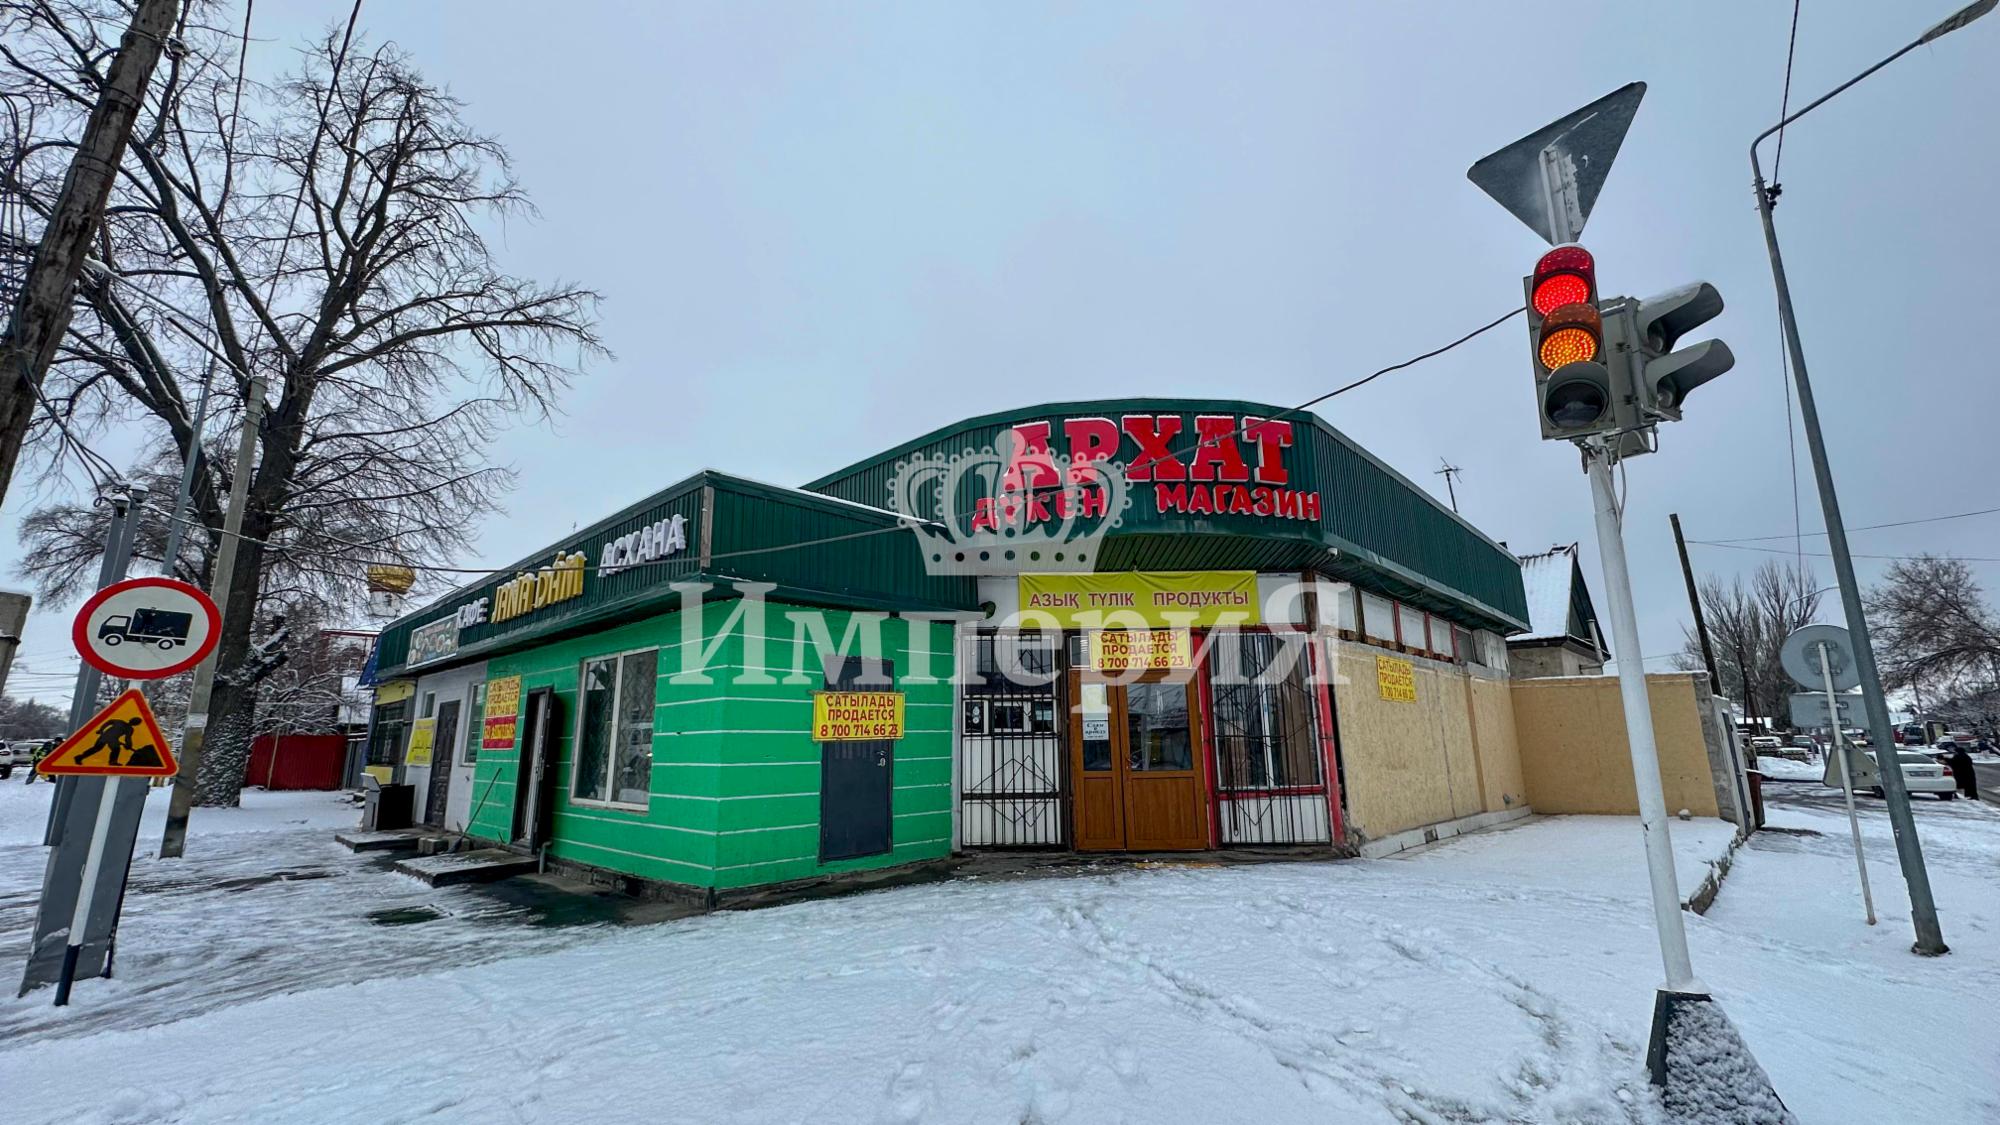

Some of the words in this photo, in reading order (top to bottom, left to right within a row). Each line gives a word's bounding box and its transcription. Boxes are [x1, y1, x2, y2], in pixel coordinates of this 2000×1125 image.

[1003, 414, 1293, 488] АРХАТ
[1154, 483, 1321, 521] МАГАЗИН
[598, 514, 688, 577] АСХАНА
[1029, 592, 1079, 609] АЗЫҚ
[1088, 592, 1135, 607] ТҮЛІК
[1153, 591, 1249, 608] ПРОДУКТЫ
[456, 597, 488, 629] КАФЕ
[1100, 631, 1178, 644] САТЫЛАДЫ
[1102, 643, 1177, 656] ПРОДАЕТСЯ
[1097, 658, 1105, 668] 8
[1107, 657, 1129, 668] 700
[1131, 657, 1151, 668] 714
[1154, 656, 1168, 667] 66
[1171, 656, 1184, 666] 23
[825, 695, 896, 708] САТЫЛАДЫ
[828, 709, 895, 722] ПРОДАЕТСЯ
[820, 724, 828, 736] 8
[831, 724, 850, 736] 700
[853, 723, 870, 736] 714
[873, 724, 886, 735] 66
[888, 723, 898, 735] 23
